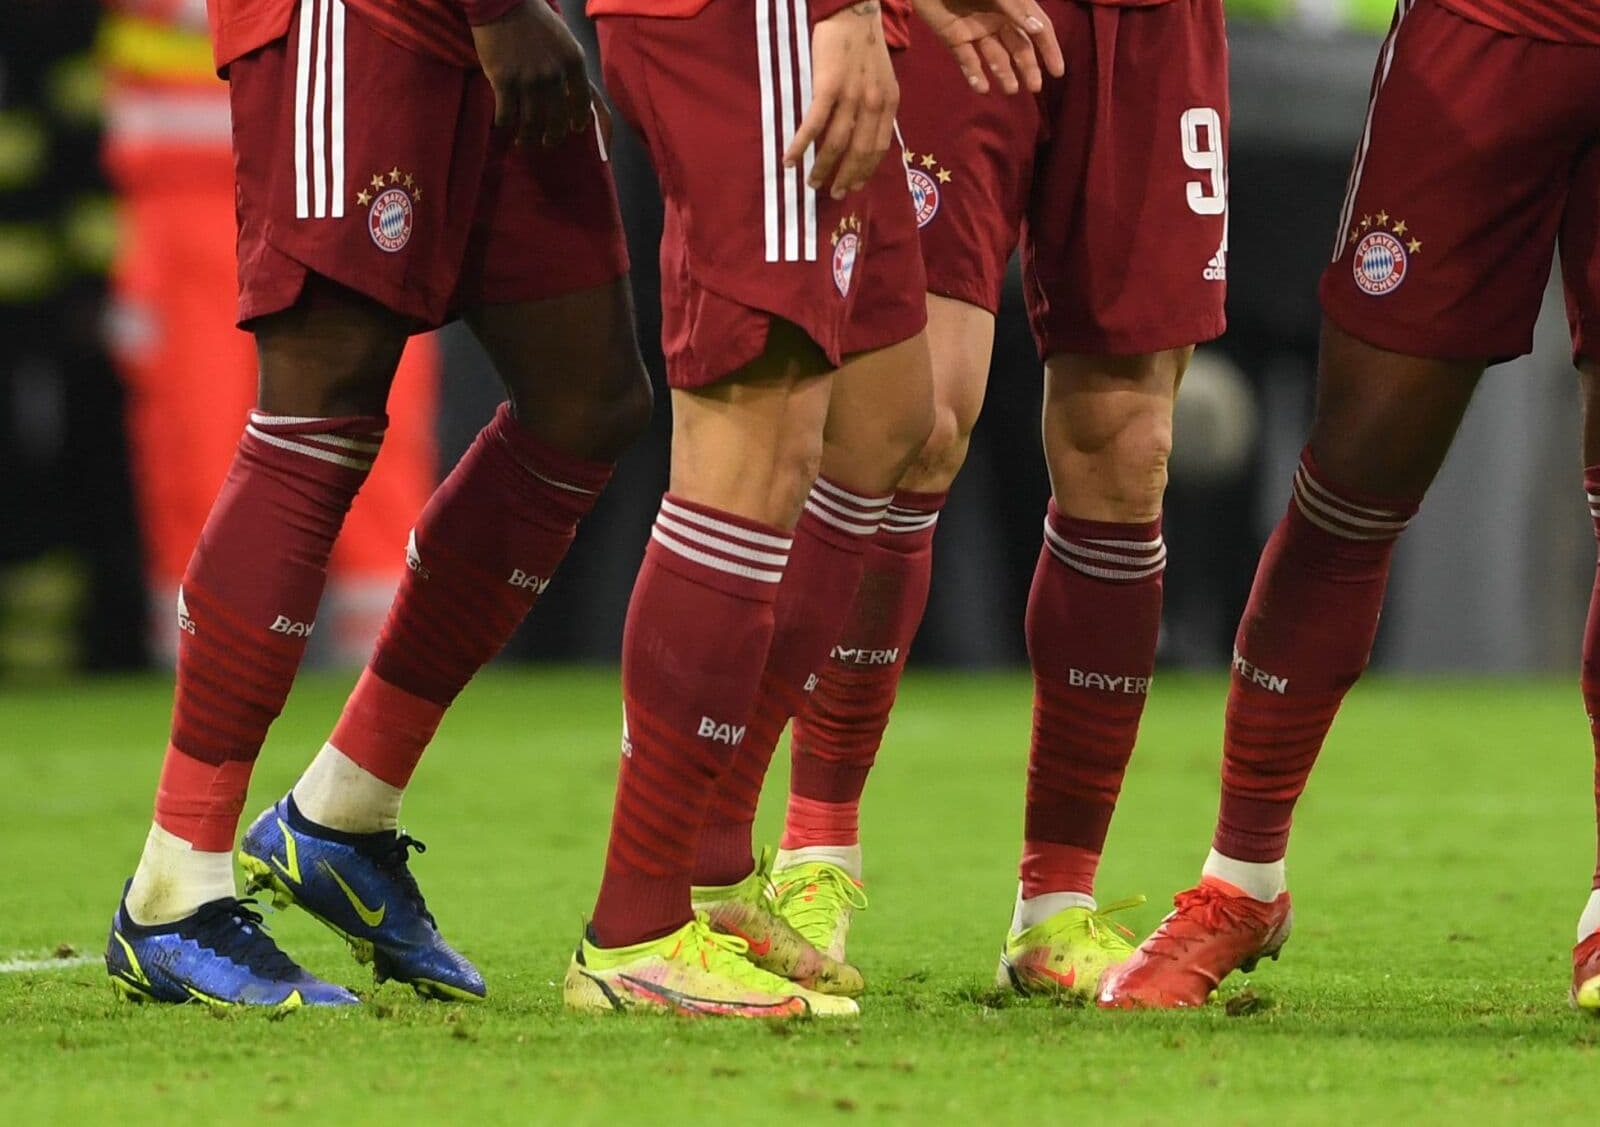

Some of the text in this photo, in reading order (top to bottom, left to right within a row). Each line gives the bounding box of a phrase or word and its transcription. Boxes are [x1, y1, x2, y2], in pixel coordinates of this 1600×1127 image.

[1180, 107, 1227, 215] 9
[383, 193, 410, 216] BAYERN
[1369, 236, 1403, 262] BAYERN
[1069, 668, 1153, 694] BAYER
